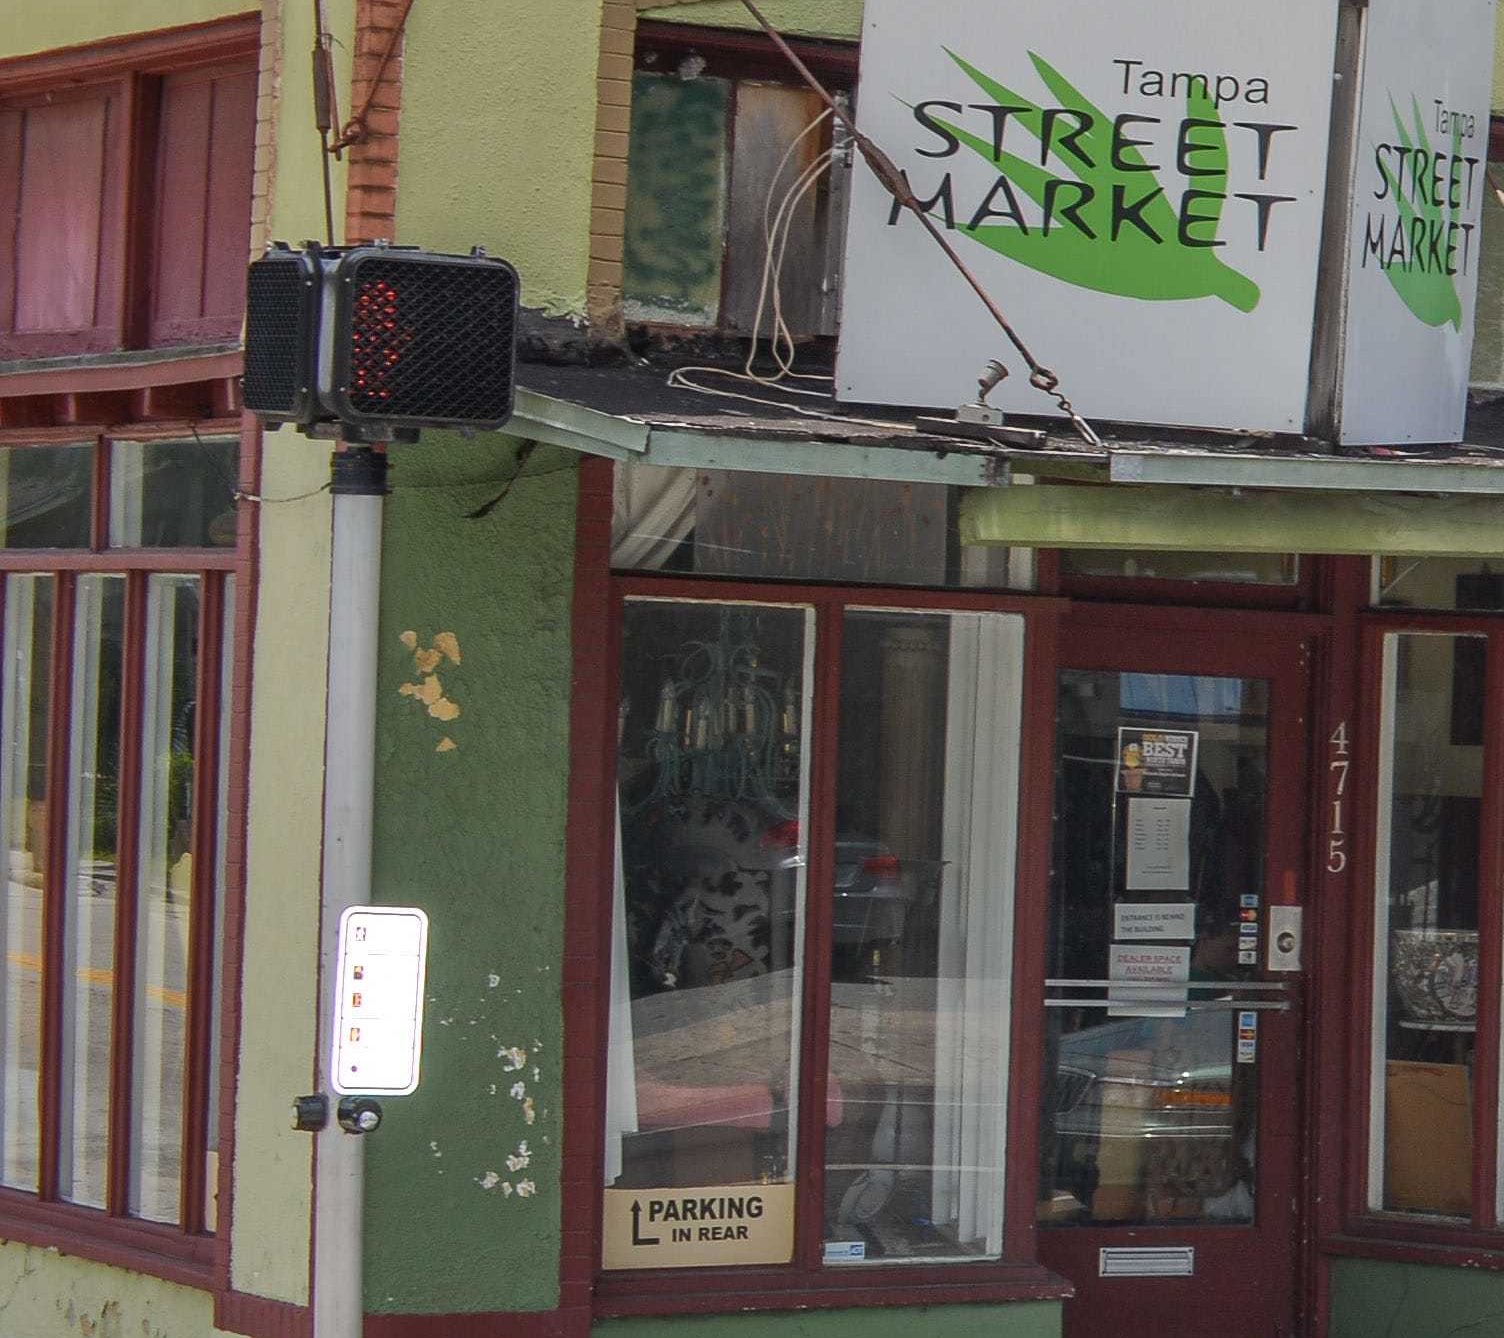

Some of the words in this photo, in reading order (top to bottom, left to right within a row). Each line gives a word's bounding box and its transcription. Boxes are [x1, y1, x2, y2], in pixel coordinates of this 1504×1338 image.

[1113, 59, 1269, 110] Tampa
[914, 100, 1299, 181] STREET
[1434, 98, 1476, 145] Tampa
[1373, 143, 1480, 211] STREET
[887, 168, 1298, 252] MARKET
[1361, 211, 1475, 276] MARKET
[1142, 741, 1188, 758] BEST
[1327, 721, 1350, 873] 4715
[649, 1196, 763, 1222] PARKING
[672, 1227, 692, 1242] IN
[699, 1225, 749, 1241] REAR
